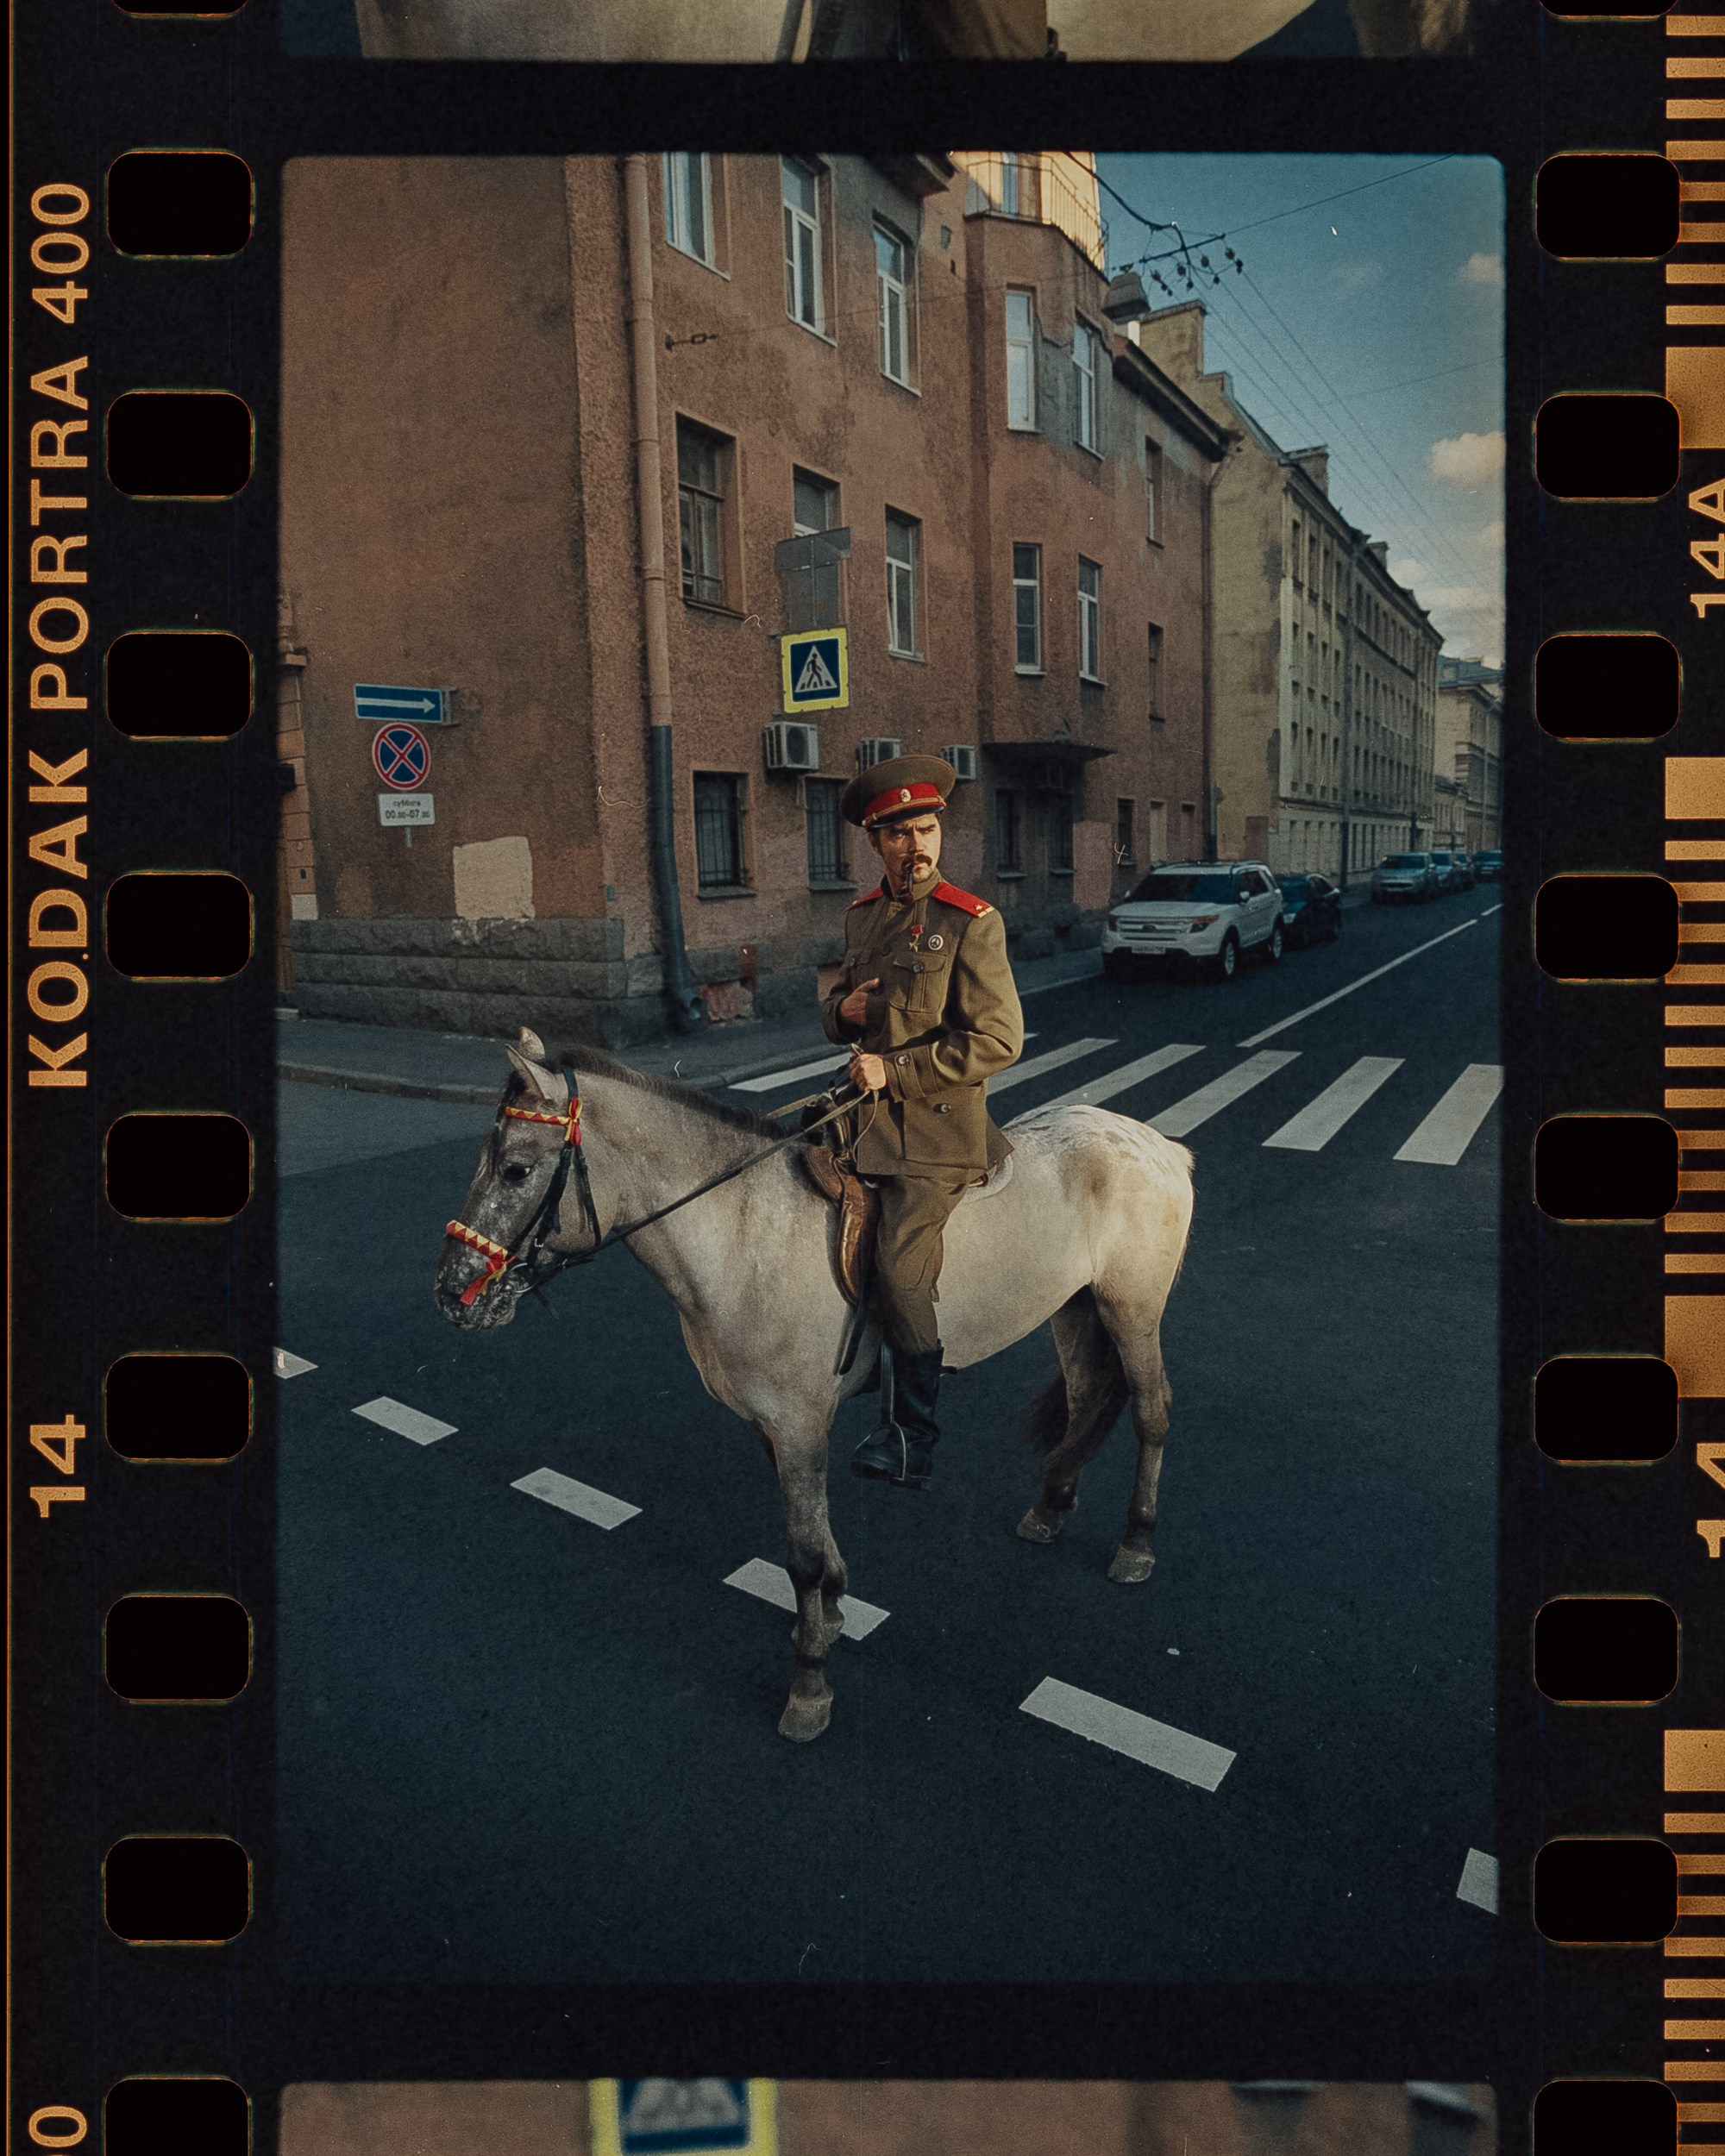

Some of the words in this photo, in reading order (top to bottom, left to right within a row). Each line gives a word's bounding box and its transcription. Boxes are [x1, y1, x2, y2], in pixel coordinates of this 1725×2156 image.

[30, 182, 90, 325] 400
[28, 355, 90, 710] PORTRA
[29, 1414, 86, 1518] 14
